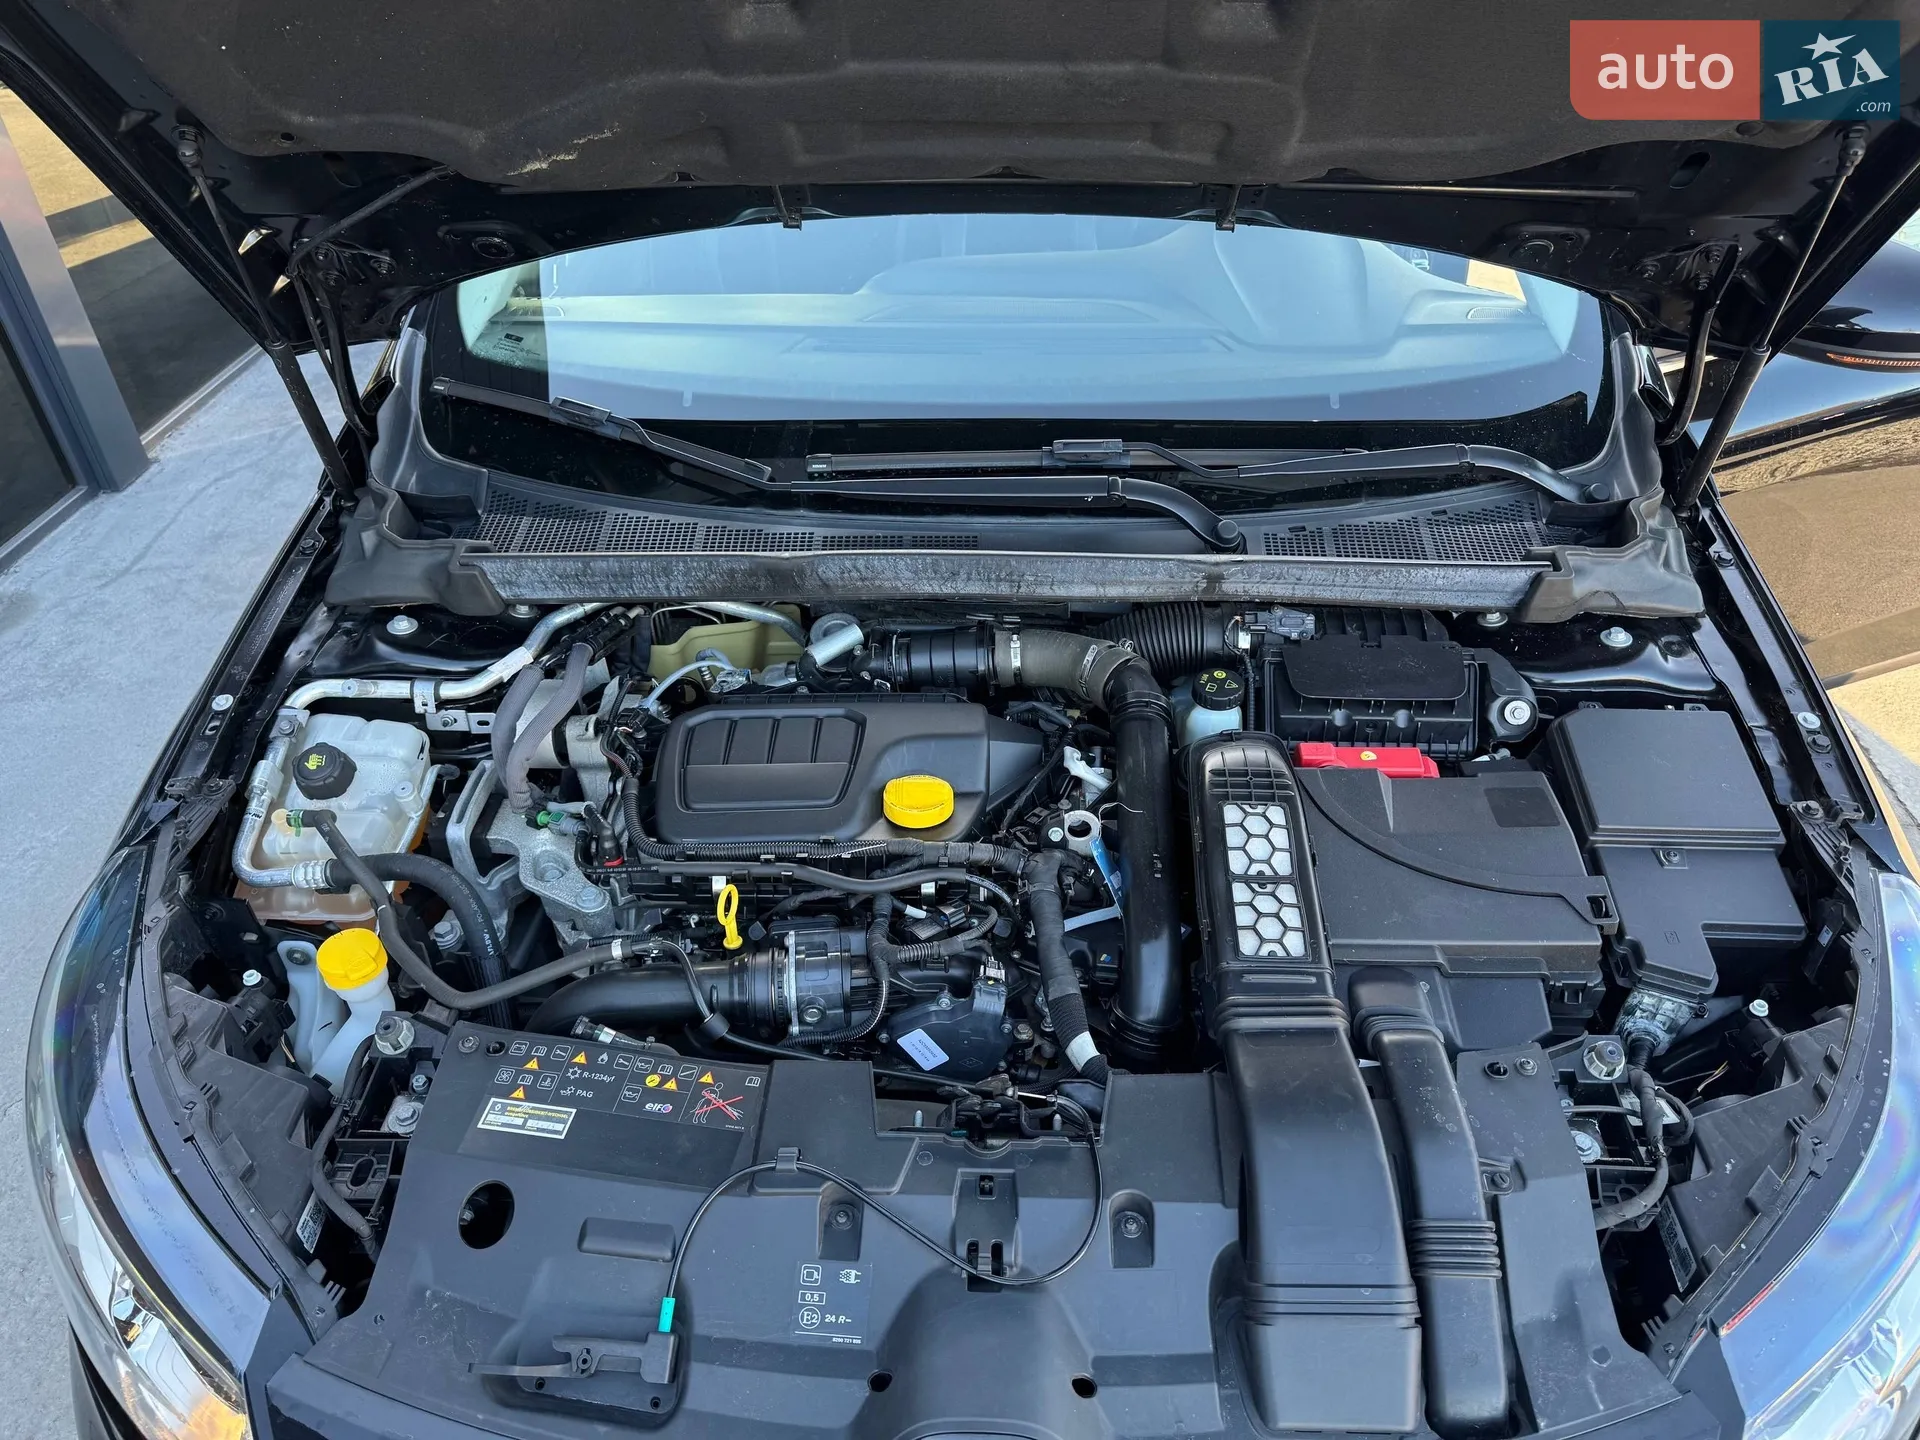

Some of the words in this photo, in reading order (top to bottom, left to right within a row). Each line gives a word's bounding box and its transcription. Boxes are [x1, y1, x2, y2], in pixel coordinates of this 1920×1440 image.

[582, 1071, 616, 1083] R-1234yf
[575, 1089, 594, 1098] PAG
[805, 1293, 819, 1302] 0,5
[803, 1311, 818, 1324] E2
[824, 1314, 836, 1323] 24
